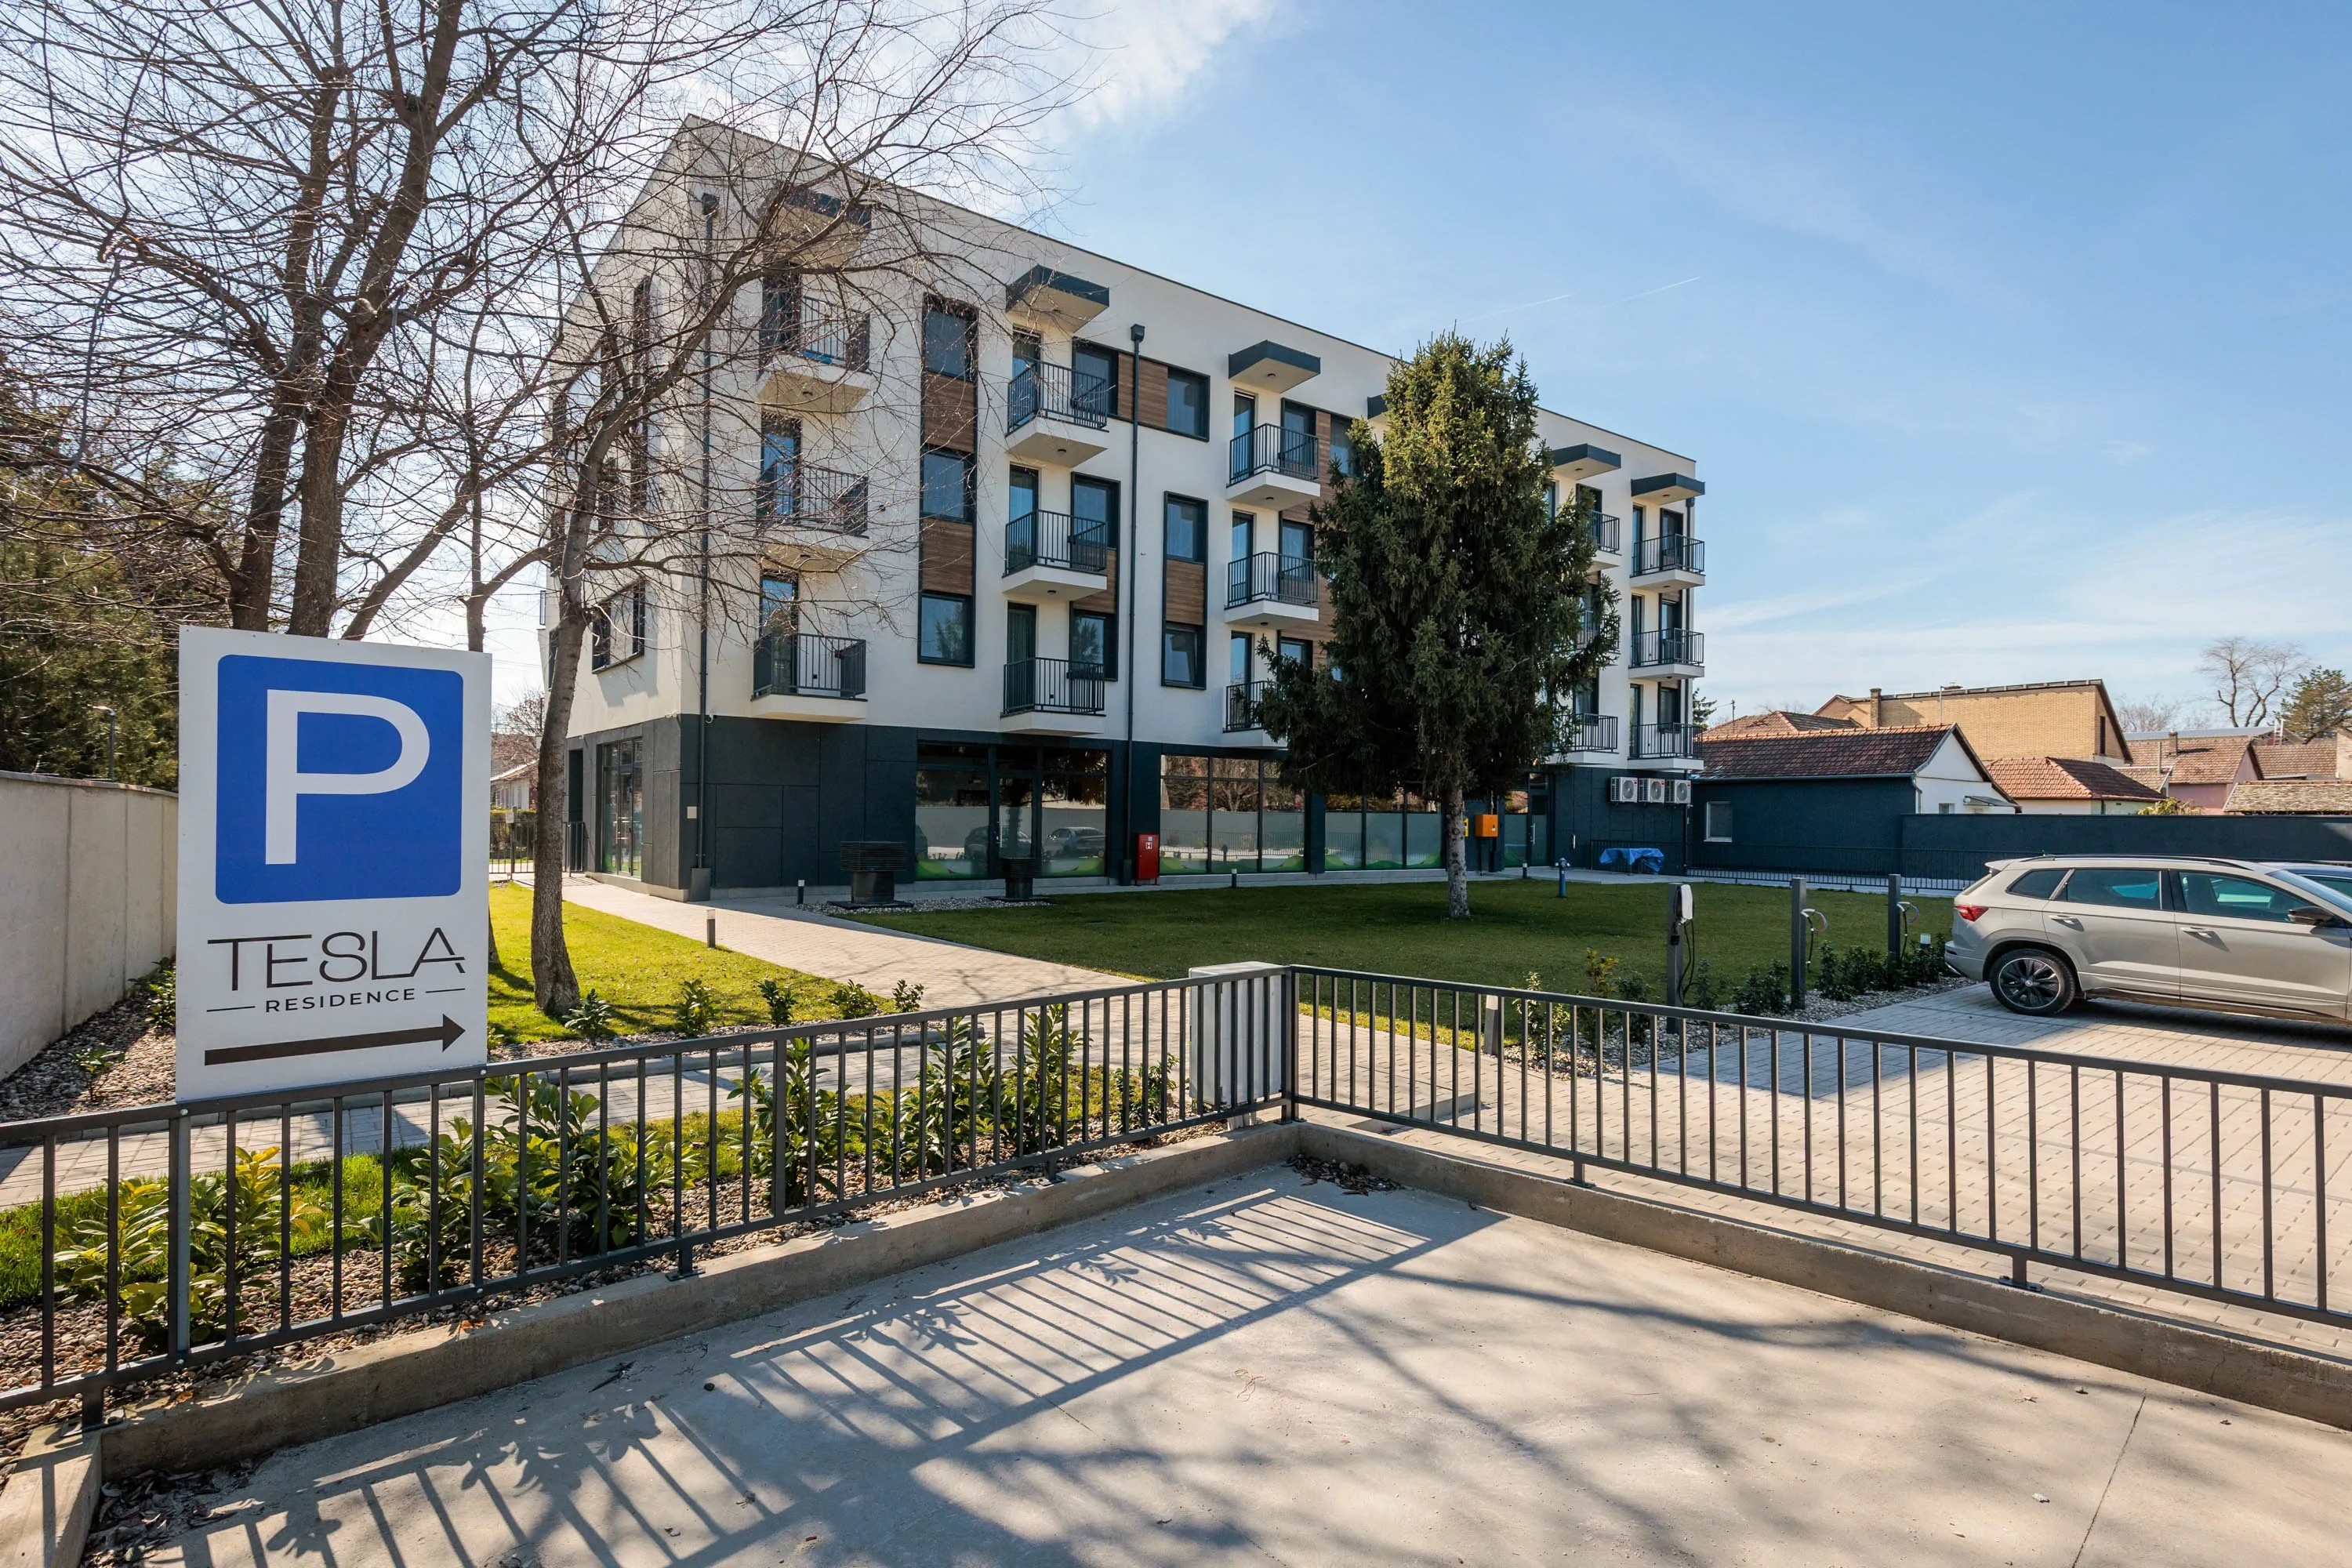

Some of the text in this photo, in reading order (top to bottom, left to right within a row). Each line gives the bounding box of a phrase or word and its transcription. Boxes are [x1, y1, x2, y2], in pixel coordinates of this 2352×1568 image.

[265, 689, 430, 865] P
[207, 927, 466, 991] TESLA
[265, 988, 416, 1013] RESIDENCE
